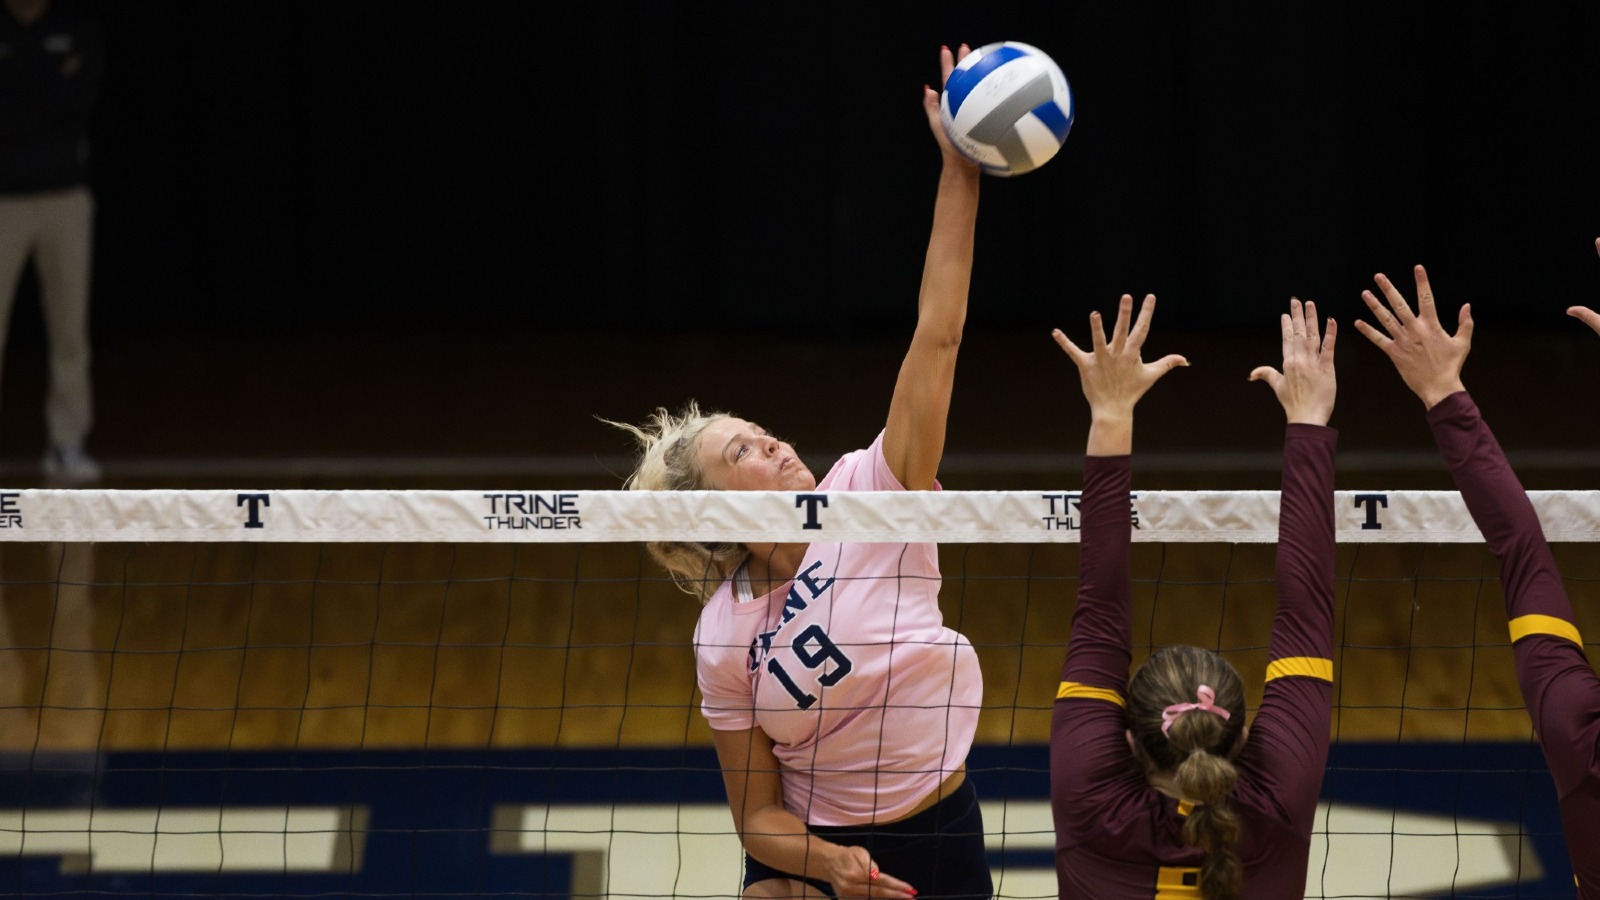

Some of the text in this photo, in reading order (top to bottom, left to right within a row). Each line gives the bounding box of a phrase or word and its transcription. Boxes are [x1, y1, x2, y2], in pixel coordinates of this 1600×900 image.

[237, 494, 270, 528] T
[484, 494, 579, 514] TRINE
[796, 495, 828, 529] T
[1354, 494, 1388, 530] T
[484, 516, 582, 529] THUNDER
[767, 624, 852, 710] 19
